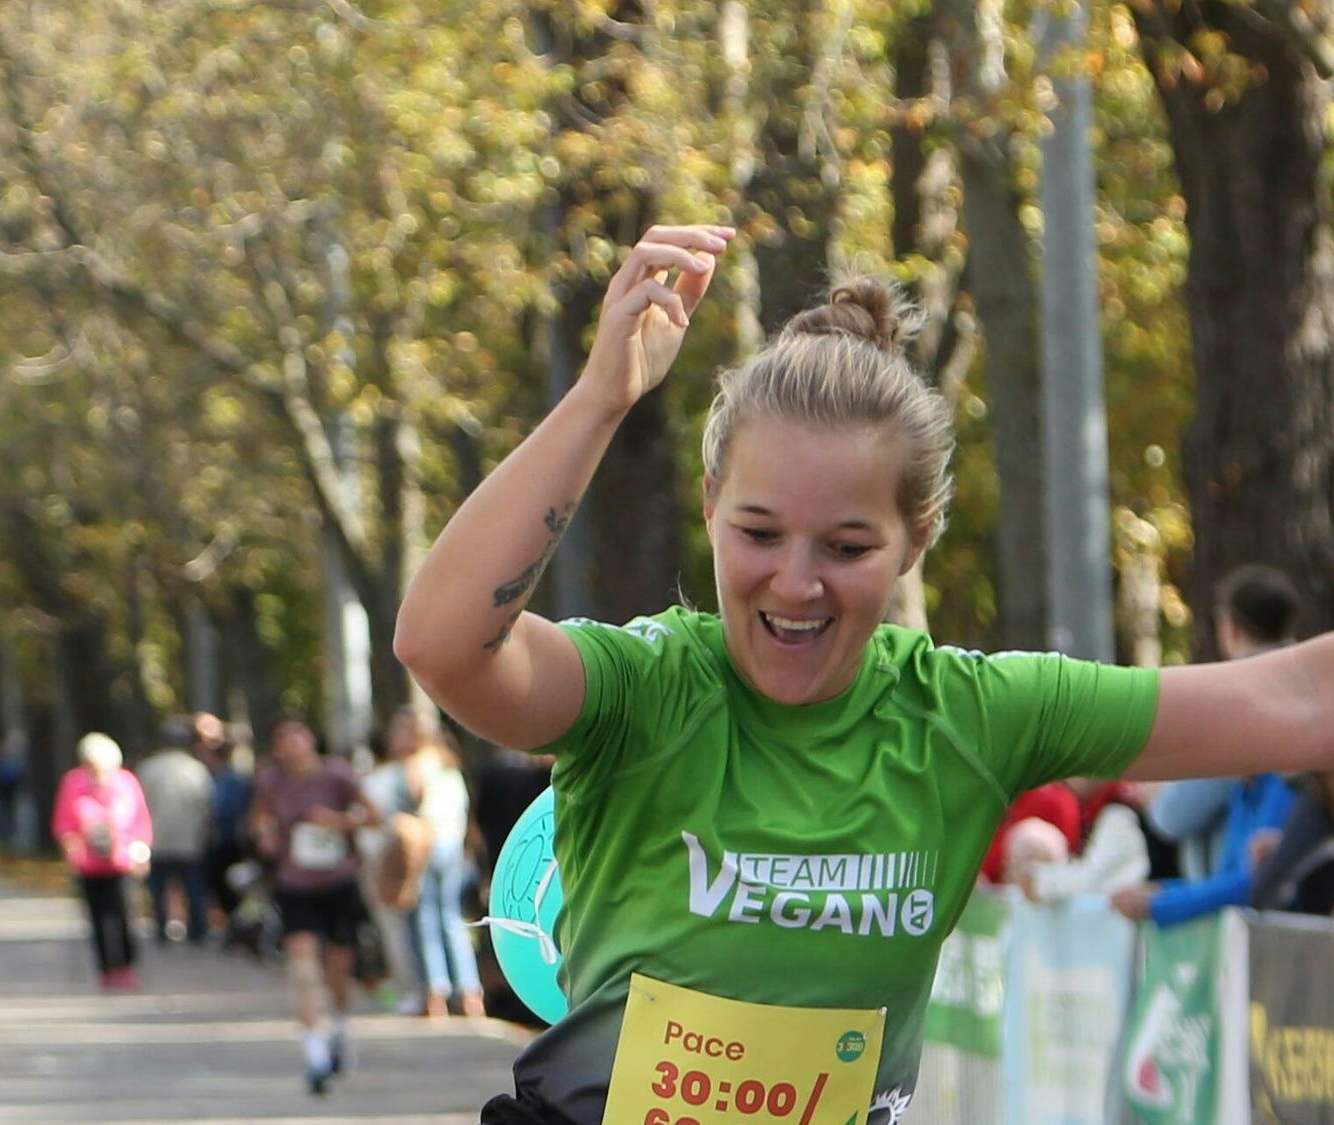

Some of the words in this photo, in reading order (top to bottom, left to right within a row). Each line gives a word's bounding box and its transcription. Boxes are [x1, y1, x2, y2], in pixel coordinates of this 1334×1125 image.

[681, 830, 899, 937] VEGAN
[744, 855, 848, 888] TEAM
[663, 1020, 746, 1061] Pace
